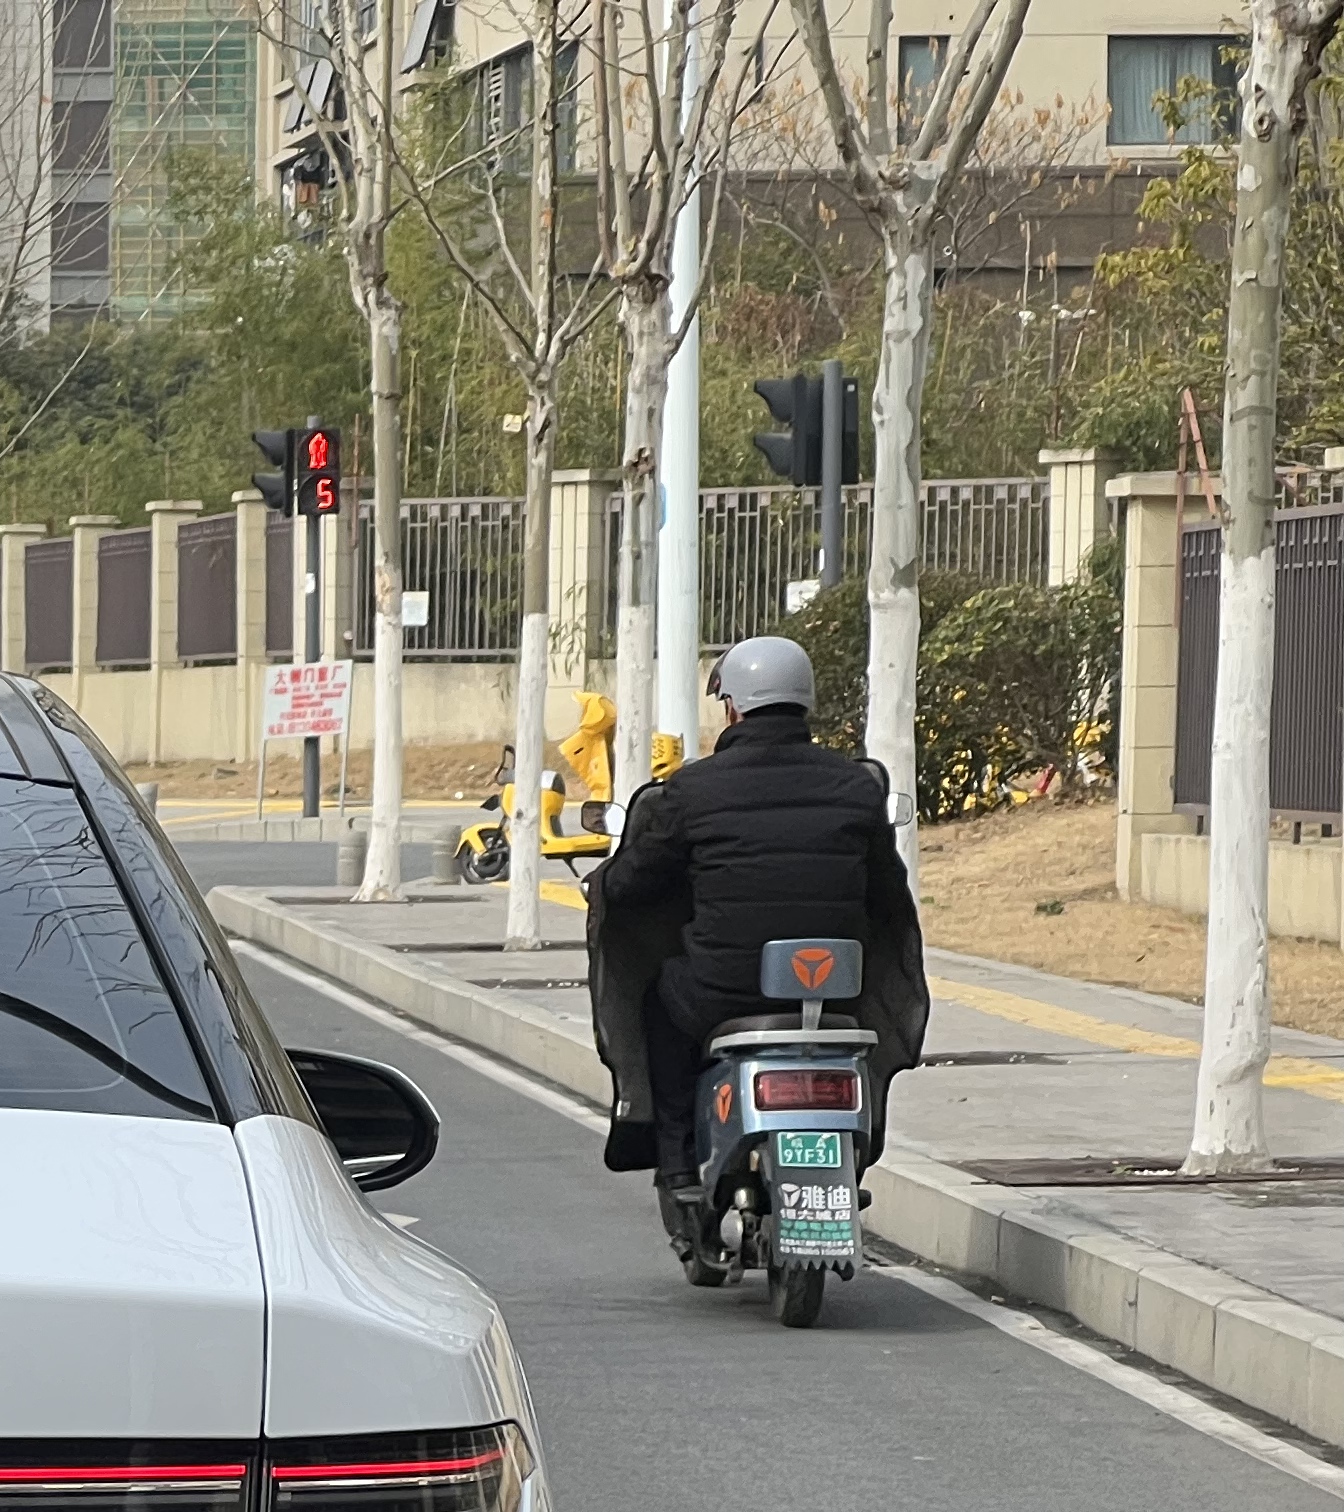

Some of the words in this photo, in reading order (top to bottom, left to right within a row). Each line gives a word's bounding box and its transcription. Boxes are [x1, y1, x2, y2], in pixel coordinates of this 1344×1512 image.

[316, 478, 335, 509] 5
[783, 1149, 833, 1163] 9YF31
[801, 1185, 852, 1210] 雅迪
